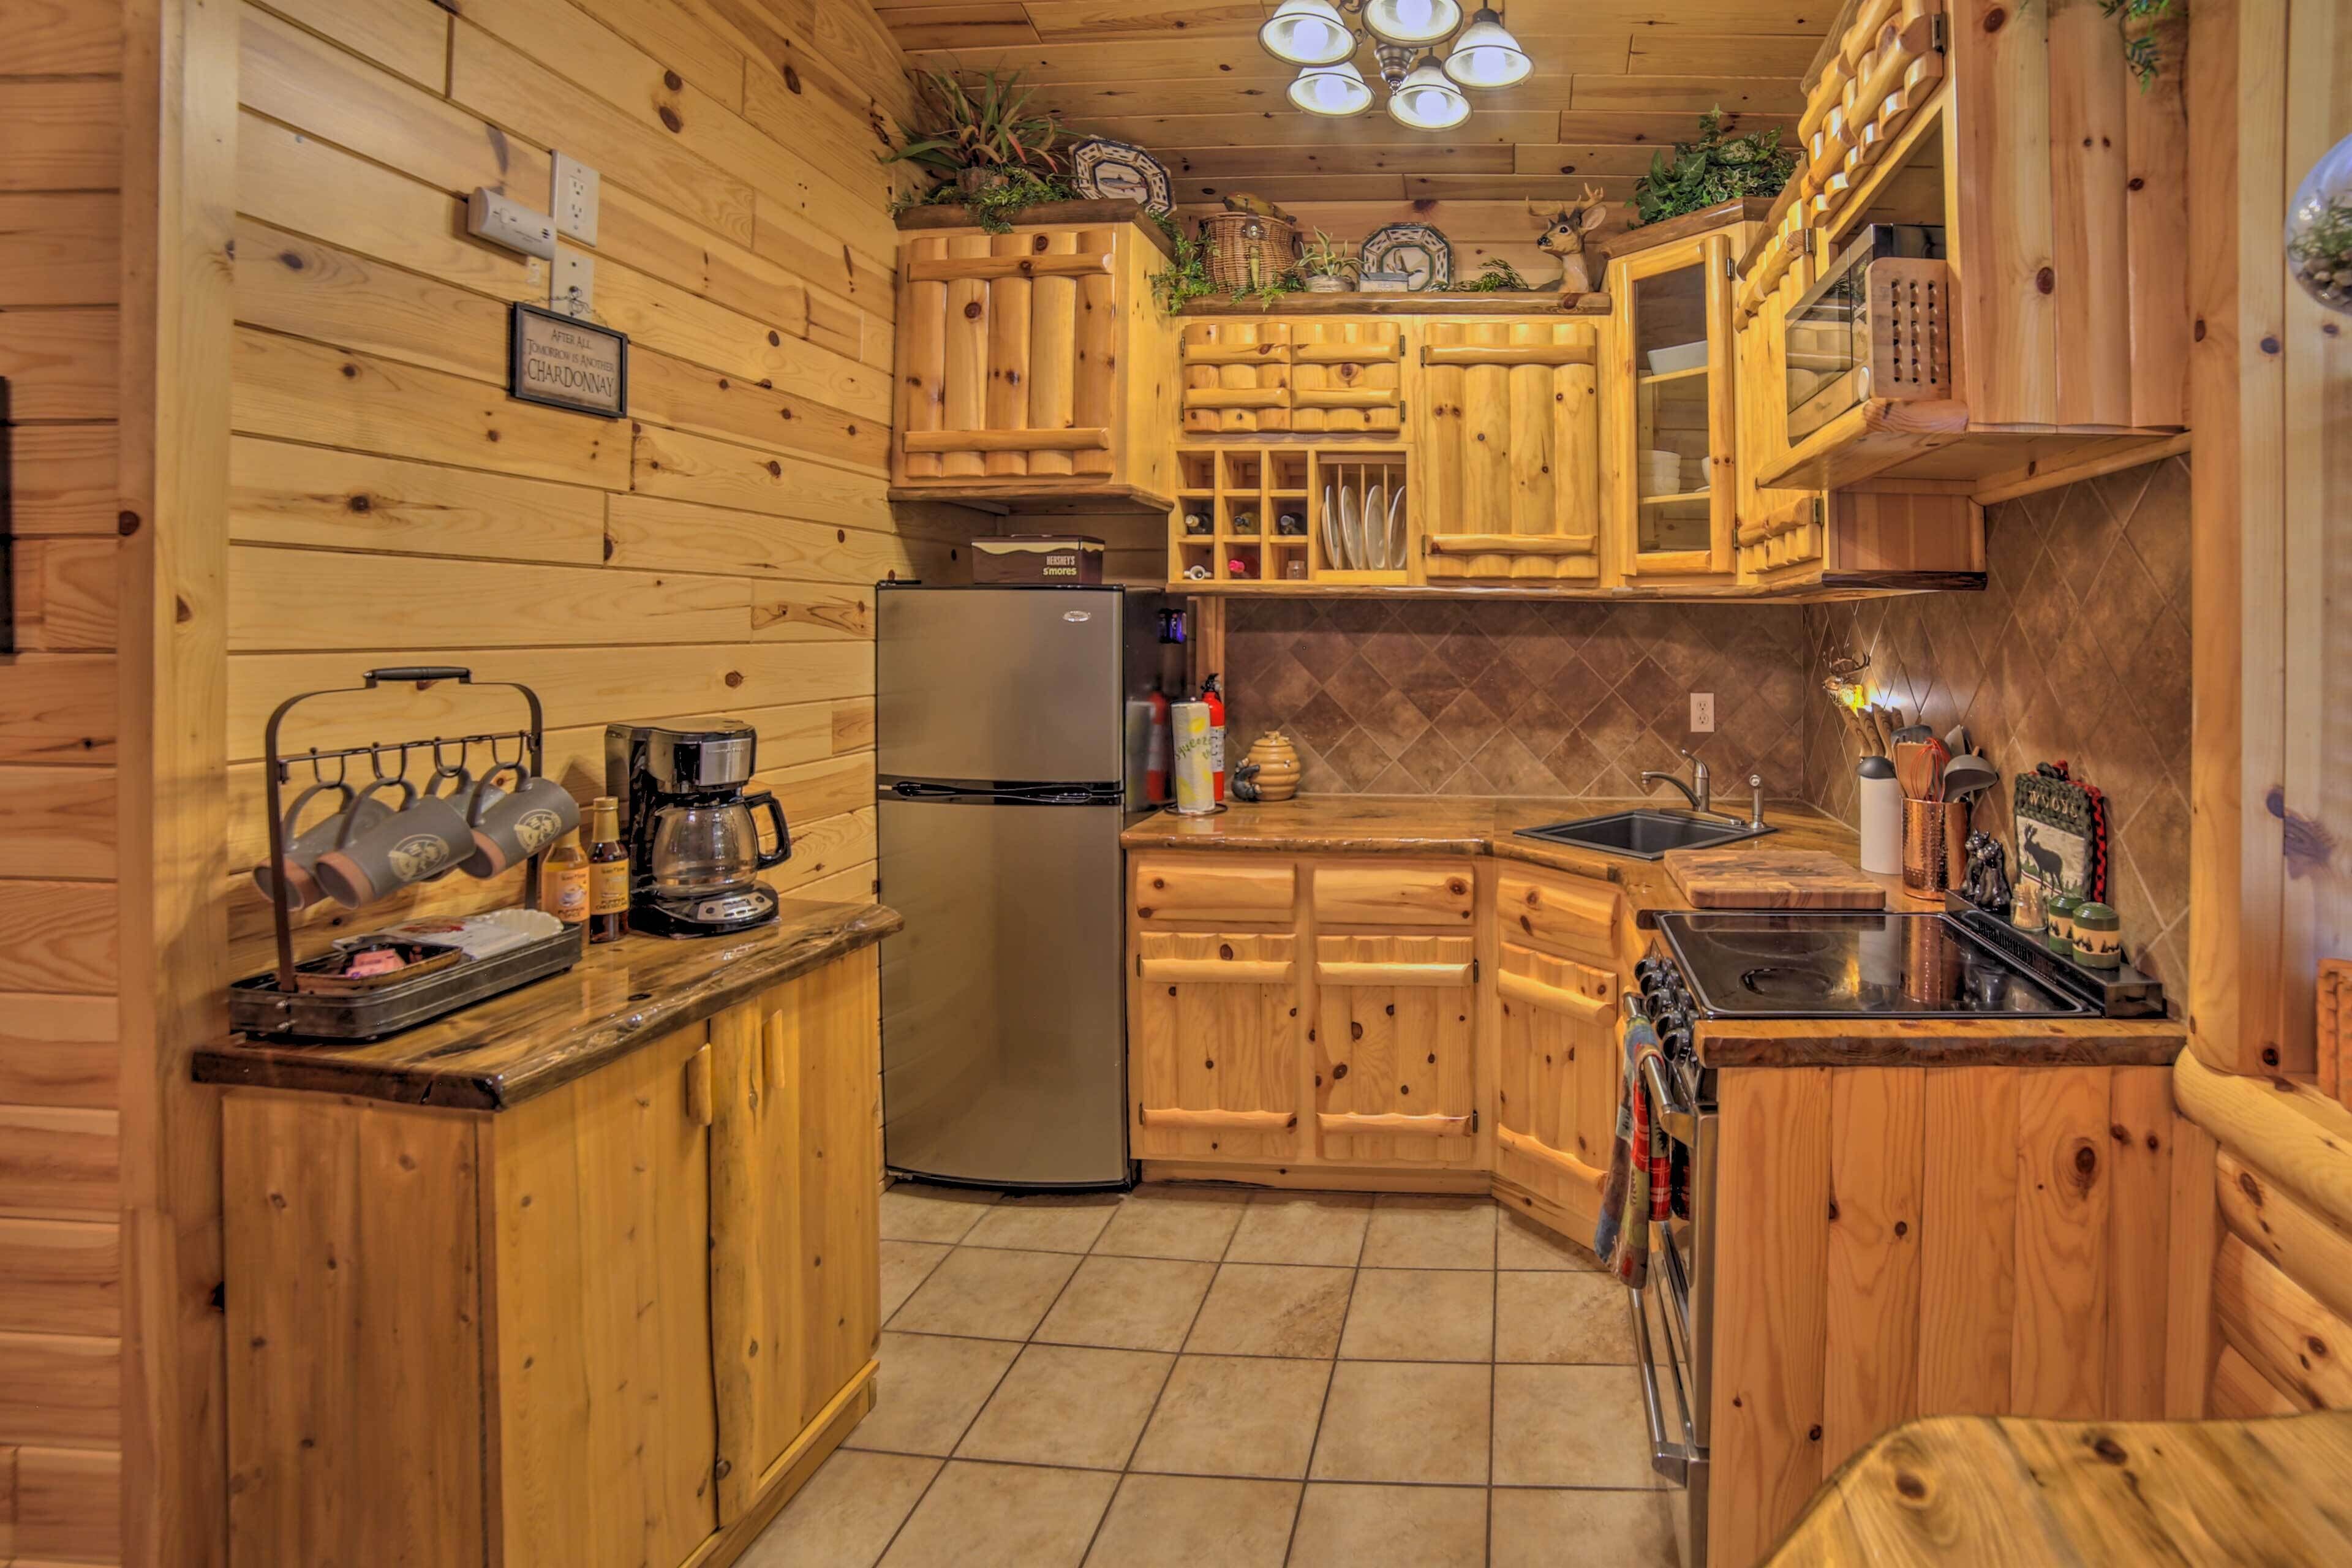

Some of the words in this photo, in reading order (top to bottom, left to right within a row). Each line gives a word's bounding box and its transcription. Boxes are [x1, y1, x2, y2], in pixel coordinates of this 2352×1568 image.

[552, 329, 575, 344] AFTER
[526, 338, 570, 360] TOMORROW
[572, 353, 579, 363] IS
[579, 355, 614, 372] ANOTHER
[528, 358, 614, 397] CHARDONNAY
[1046, 556, 1075, 565] HERSHEY'S
[1043, 567, 1076, 575] s'mores
